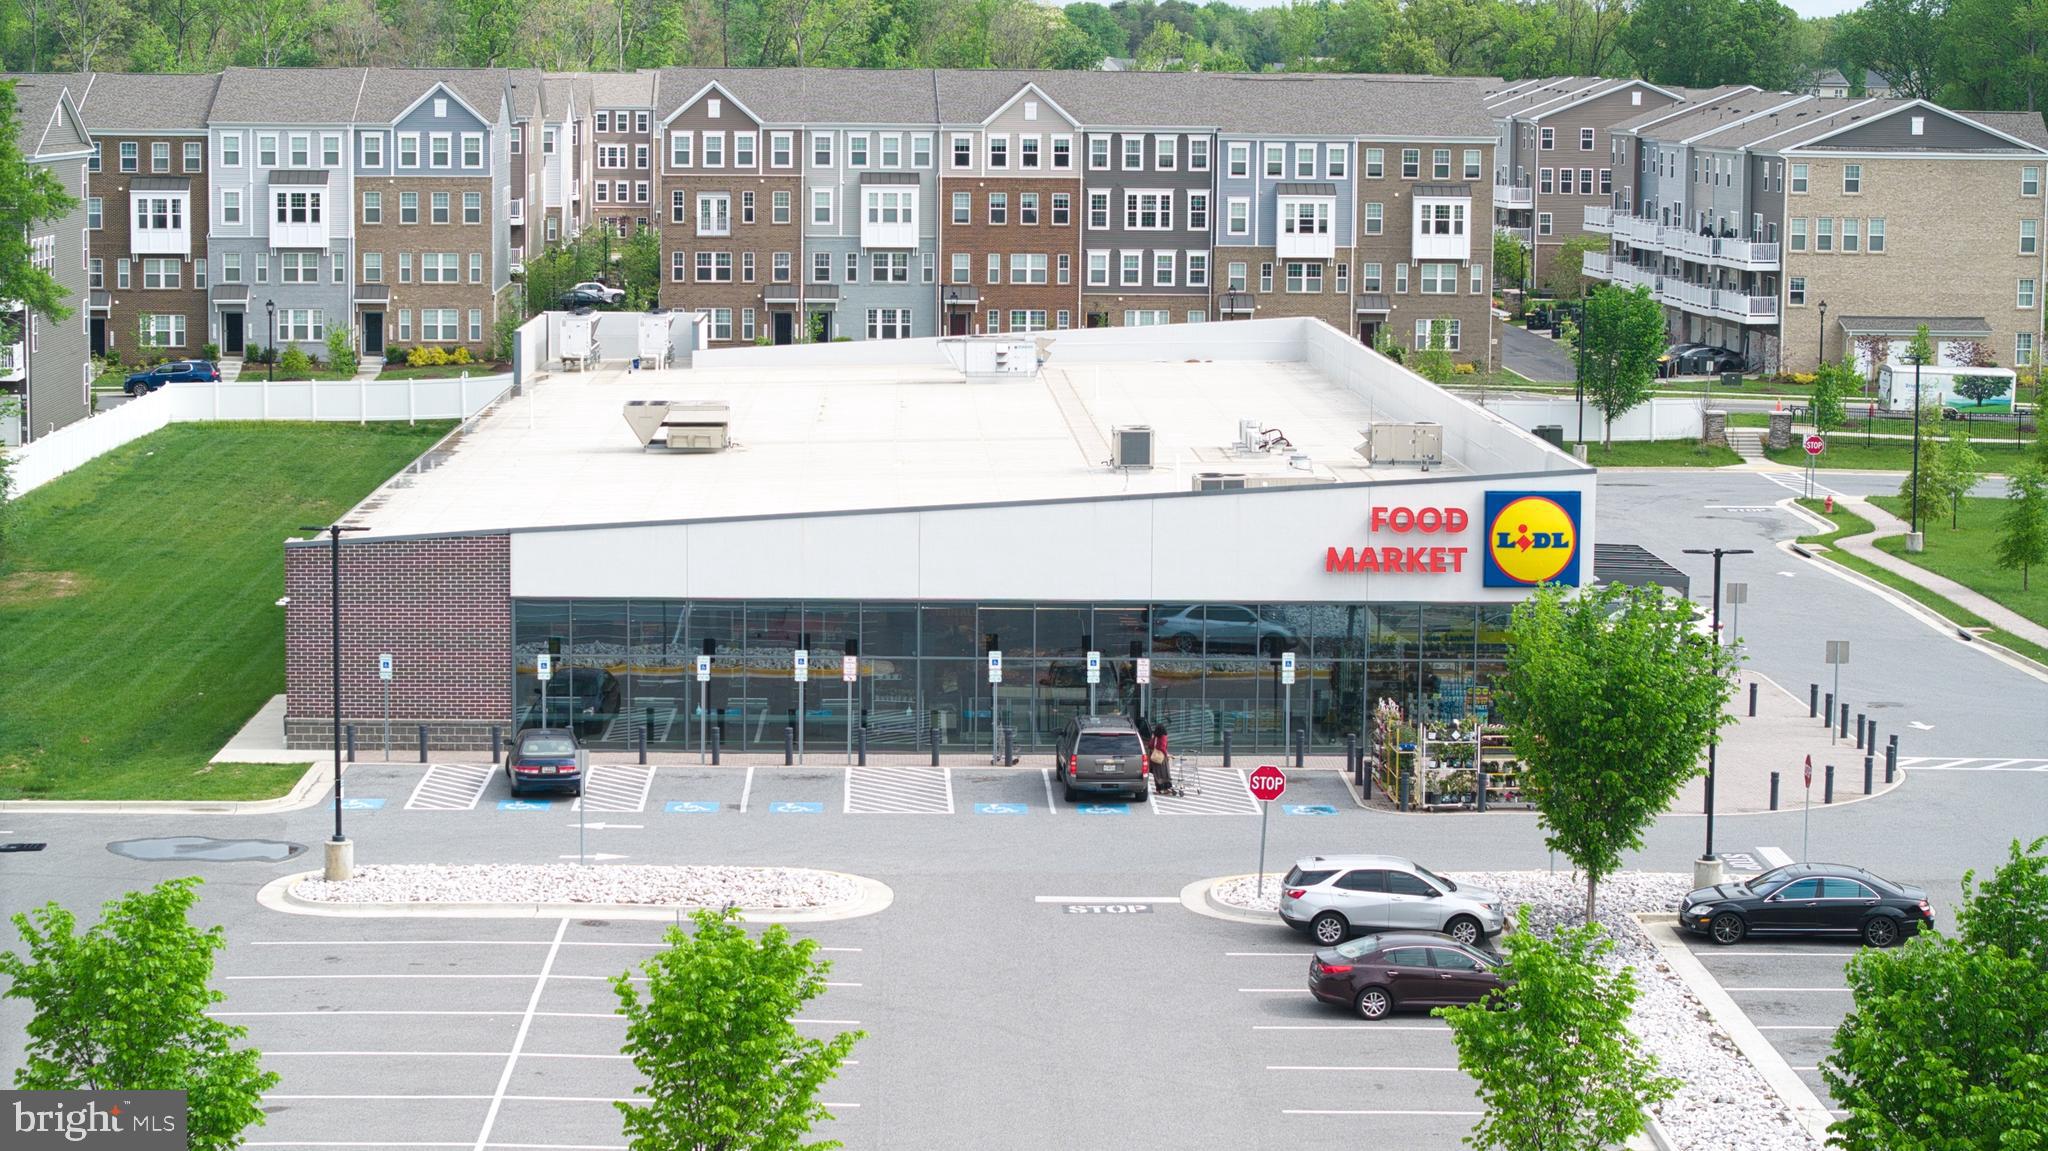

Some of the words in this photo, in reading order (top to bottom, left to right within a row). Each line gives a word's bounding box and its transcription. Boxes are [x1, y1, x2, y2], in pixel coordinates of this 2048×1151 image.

[1806, 441, 1823, 450] STOP
[1371, 507, 1469, 533] FOOD
[1325, 546, 1468, 573] MARKET
[1251, 775, 1284, 790] STOP
[1720, 853, 1763, 871] STOP
[1068, 904, 1148, 914] STOP
